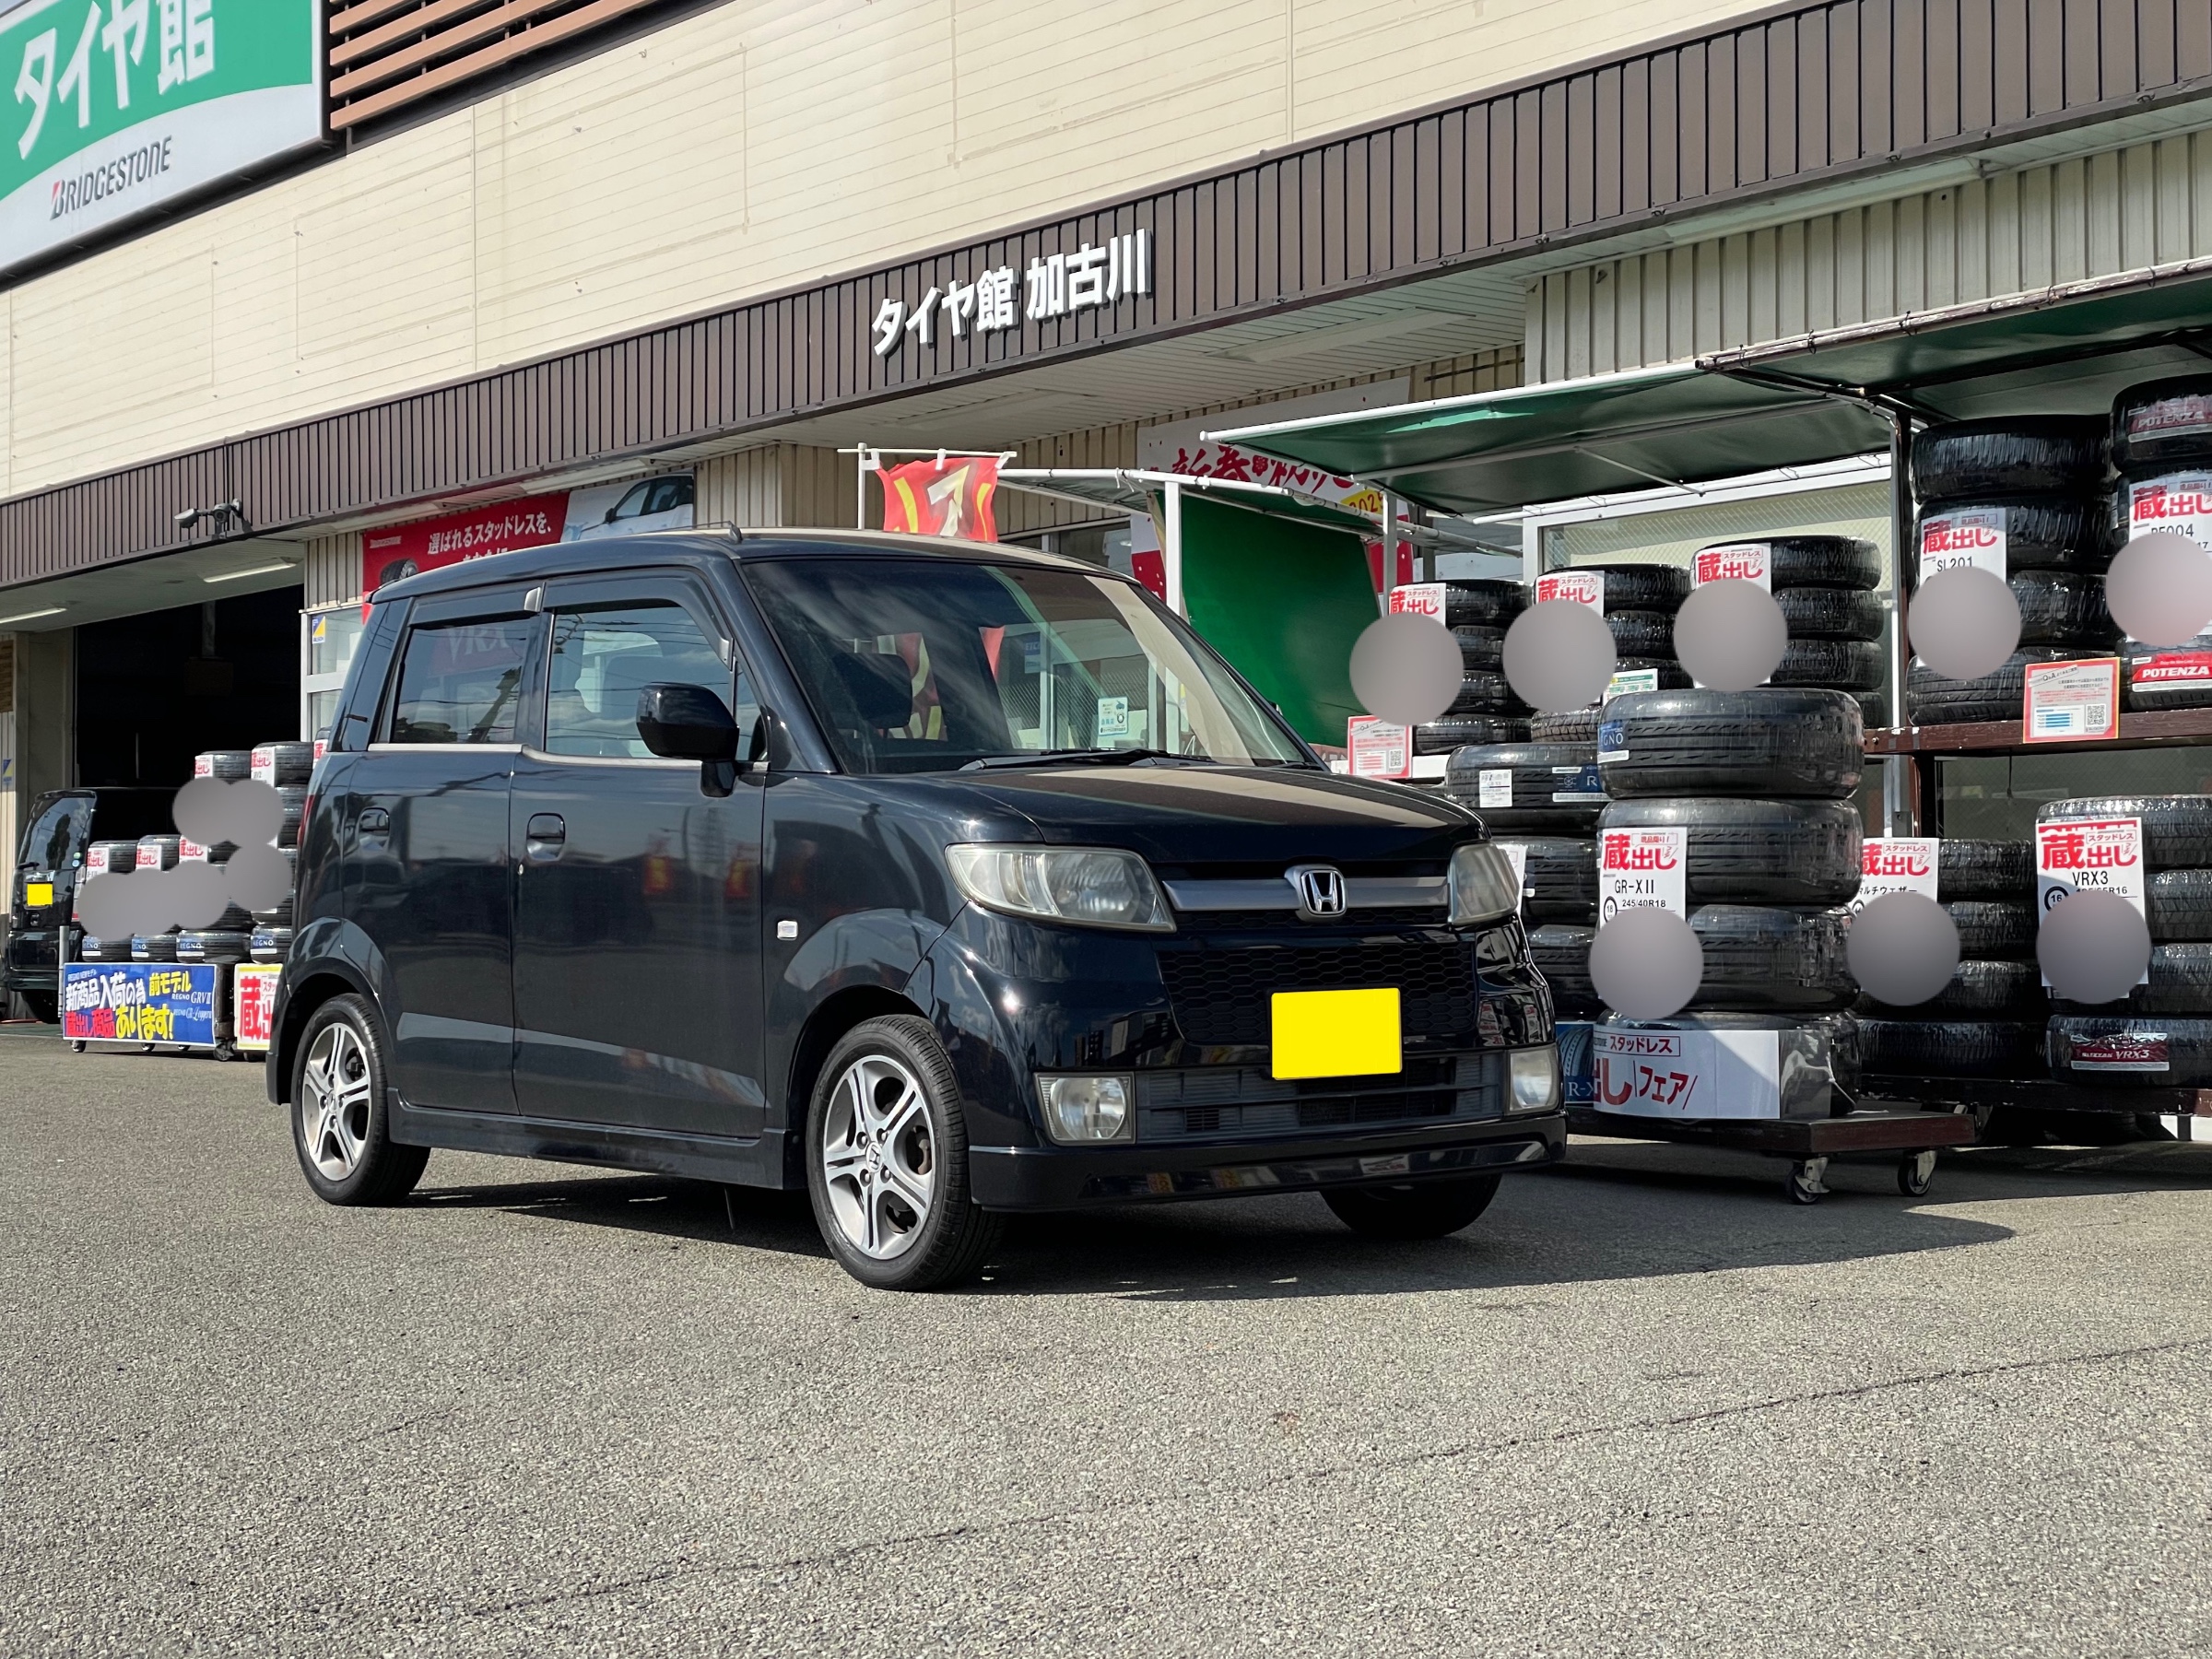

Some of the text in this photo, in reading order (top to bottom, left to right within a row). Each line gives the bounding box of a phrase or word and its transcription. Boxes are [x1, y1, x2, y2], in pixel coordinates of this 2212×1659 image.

[14, 0, 215, 160] タイヤ館
[50, 135, 172, 221] BRIDGESTONE
[871, 228, 1152, 357] タイヤ館 加古川
[2138, 411, 2204, 429] POTENZA
[2133, 485, 2212, 523] 蔵出し
[428, 512, 551, 555] 選ばれるスタッドレスを、
[1924, 520, 1997, 555] 蔵出し
[1698, 553, 1763, 584] 蔵出し
[1390, 590, 1439, 615] 蔵出し
[1538, 578, 1596, 604] 蔵出し
[2142, 666, 2209, 678] POTENZA
[2088, 833, 2135, 841] スタッドレス
[1604, 834, 1677, 870] 蔵出し
[2041, 834, 2137, 870] 蔵出し
[2072, 871, 2109, 887] VRX3
[1622, 900, 1666, 908] 245/40R18
[2051, 894, 2063, 902] 16
[65, 971, 146, 1012] 新商品入荷の為
[149, 971, 192, 996] 前モデル
[1610, 1035, 1673, 1053] スタッドレス
[2115, 1050, 2150, 1060] VRX3
[1639, 1065, 1689, 1105] フェア
